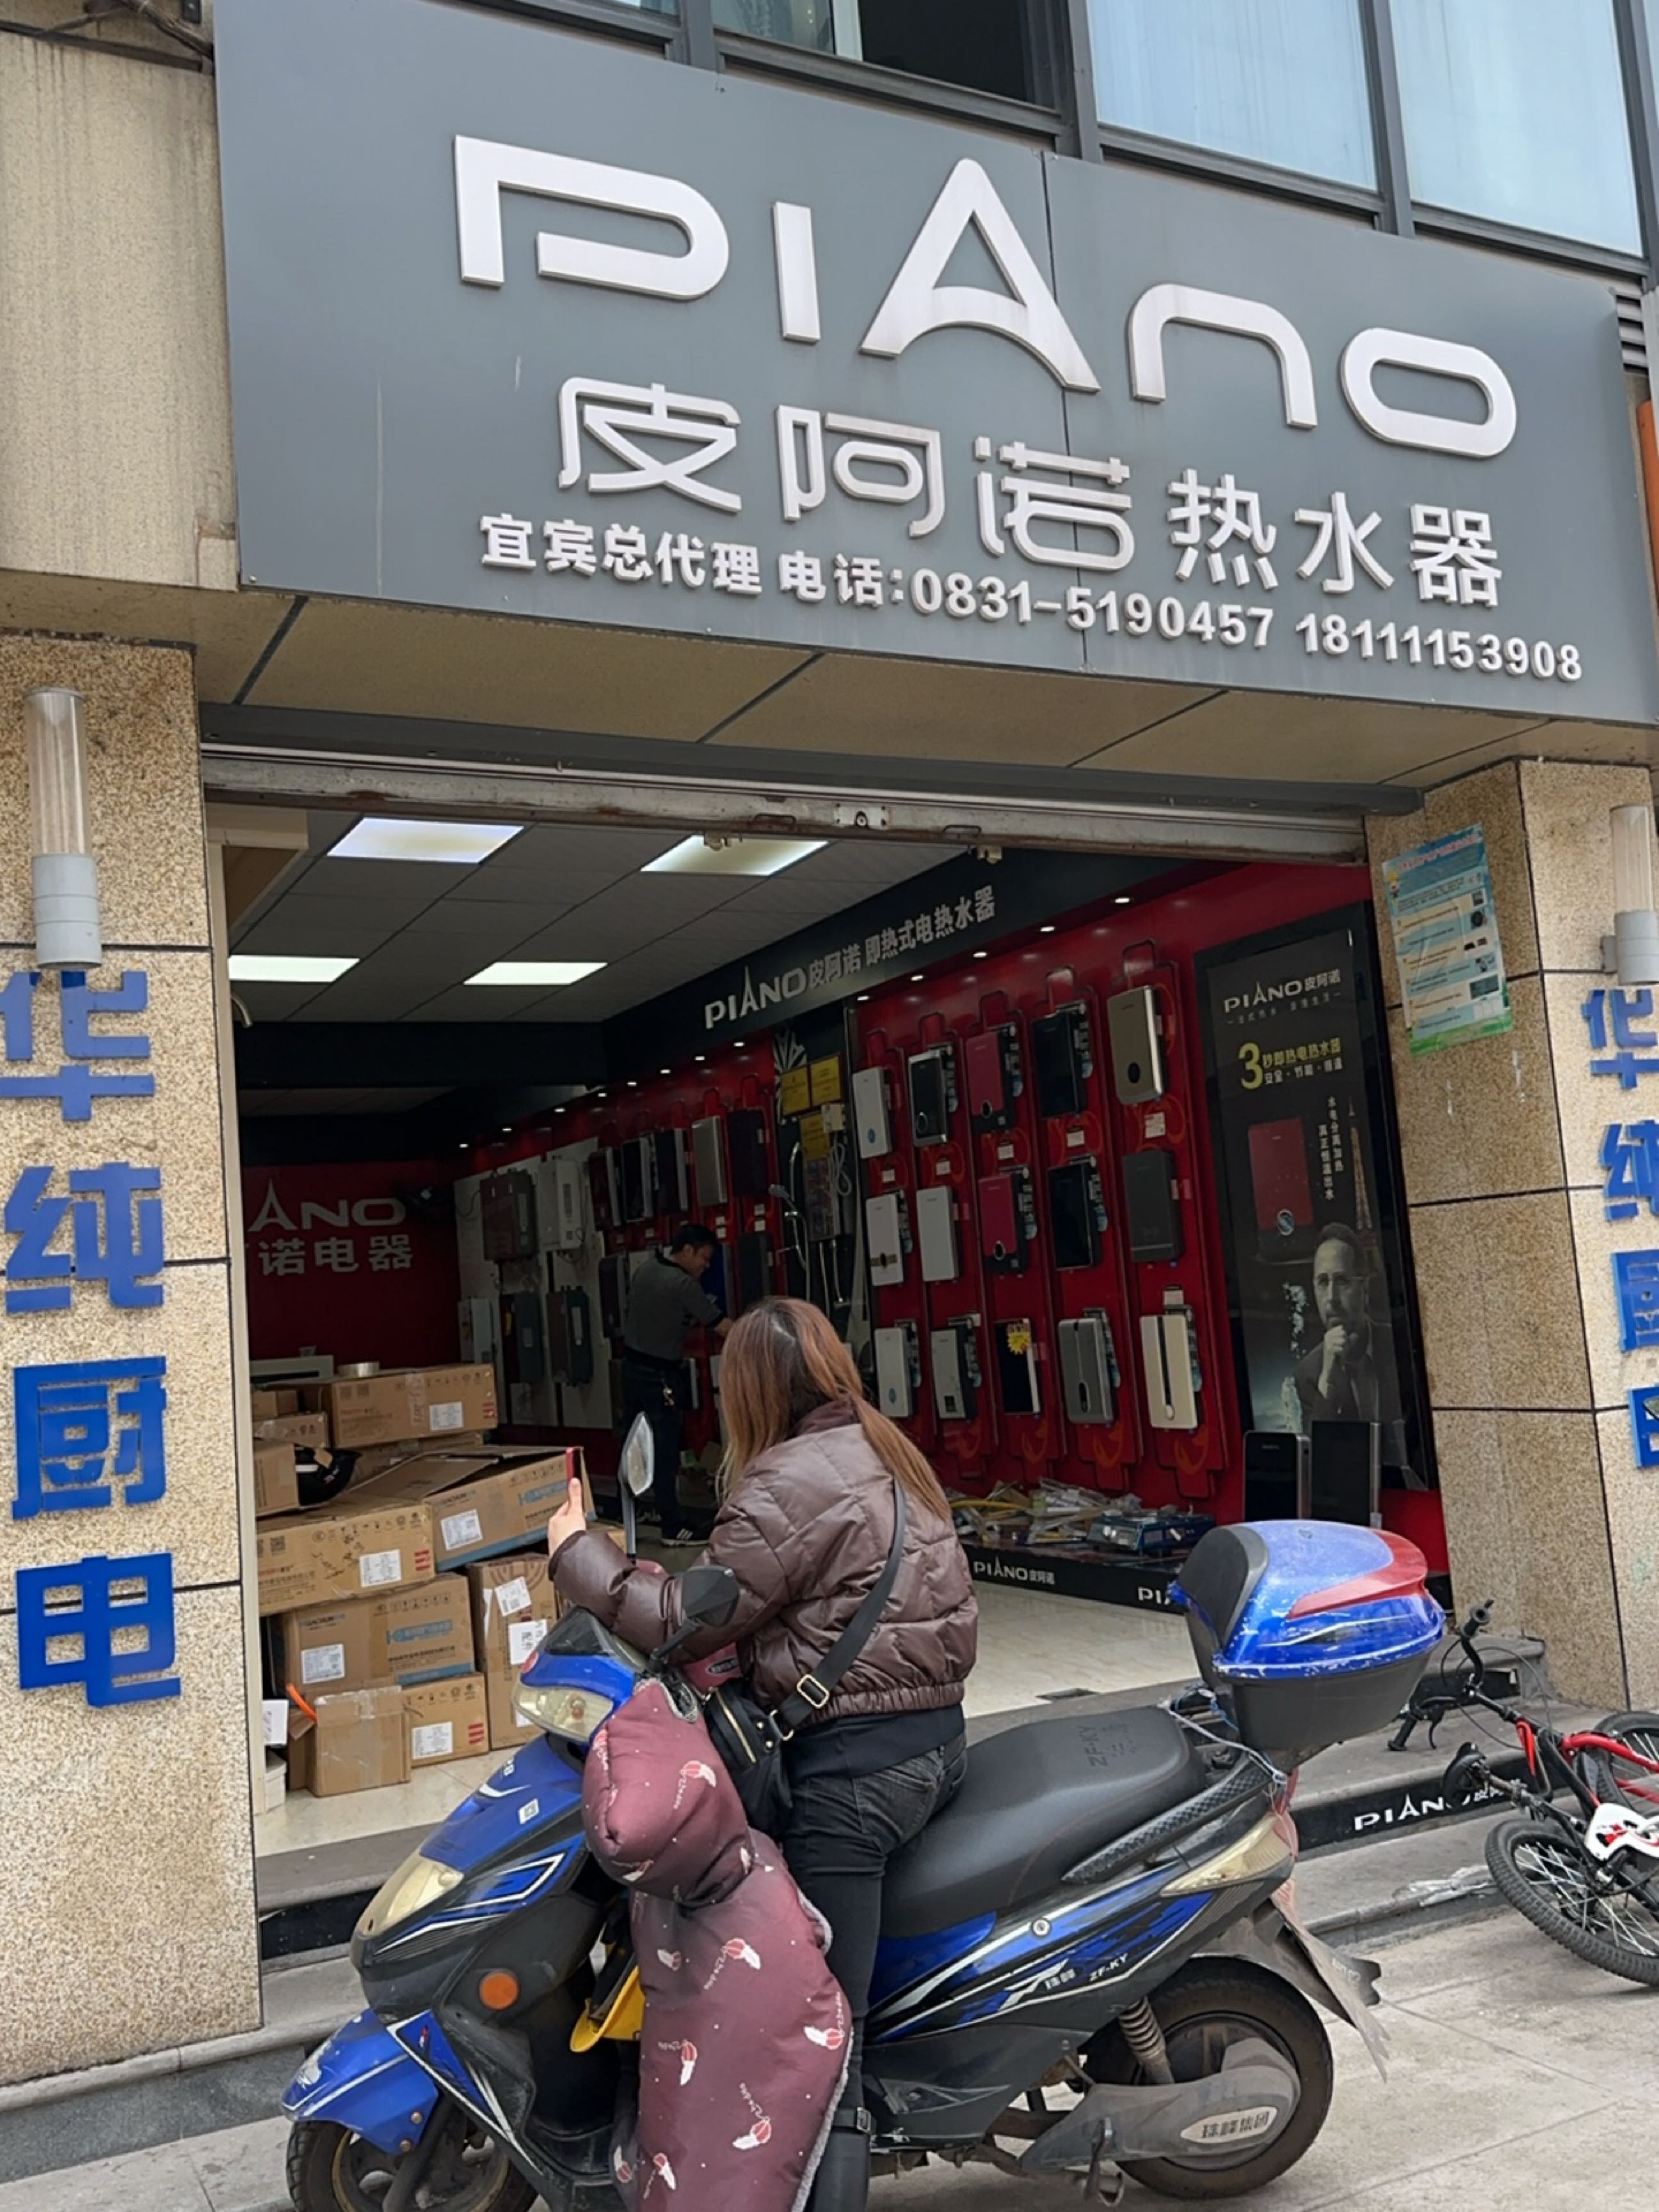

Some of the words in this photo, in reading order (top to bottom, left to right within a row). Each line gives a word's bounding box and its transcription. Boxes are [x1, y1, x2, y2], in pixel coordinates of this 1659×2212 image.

[480, 513, 763, 595] 宜宾总代理
[1295, 613, 1583, 682] 18111153908
[0, 970, 180, 1708] 华纯厨电
[1354, 1793, 1471, 1831] PIAN
